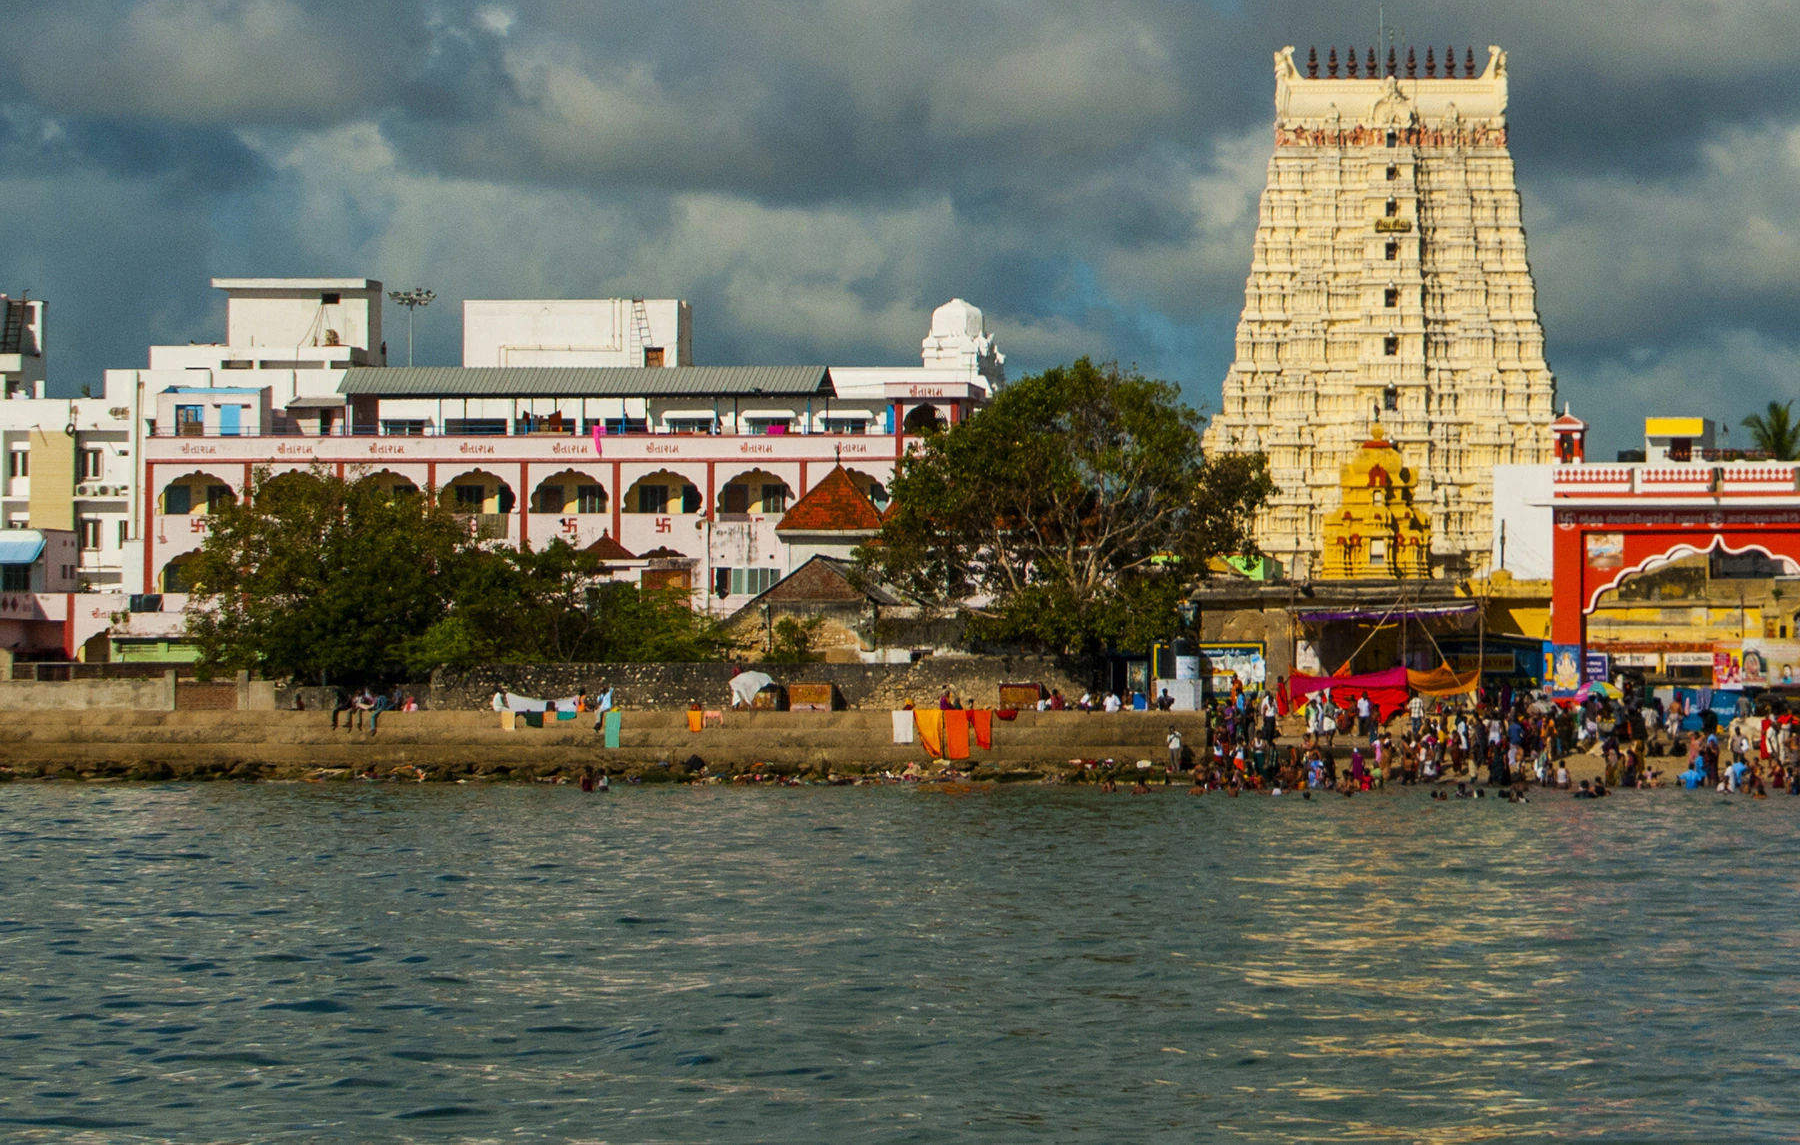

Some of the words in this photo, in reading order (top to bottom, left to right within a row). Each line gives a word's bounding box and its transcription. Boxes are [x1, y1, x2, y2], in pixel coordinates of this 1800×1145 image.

[908, 384, 943, 397] સીતારામ
[181, 442, 216, 454] સીતારામ
[277, 442, 313, 454] સીતારામ
[369, 442, 405, 454] સીતારામ
[459, 442, 495, 454] સીતારામ
[552, 442, 588, 454] સીતારામ
[646, 441, 679, 453] સીતારામ
[739, 441, 773, 453] સીતારામ
